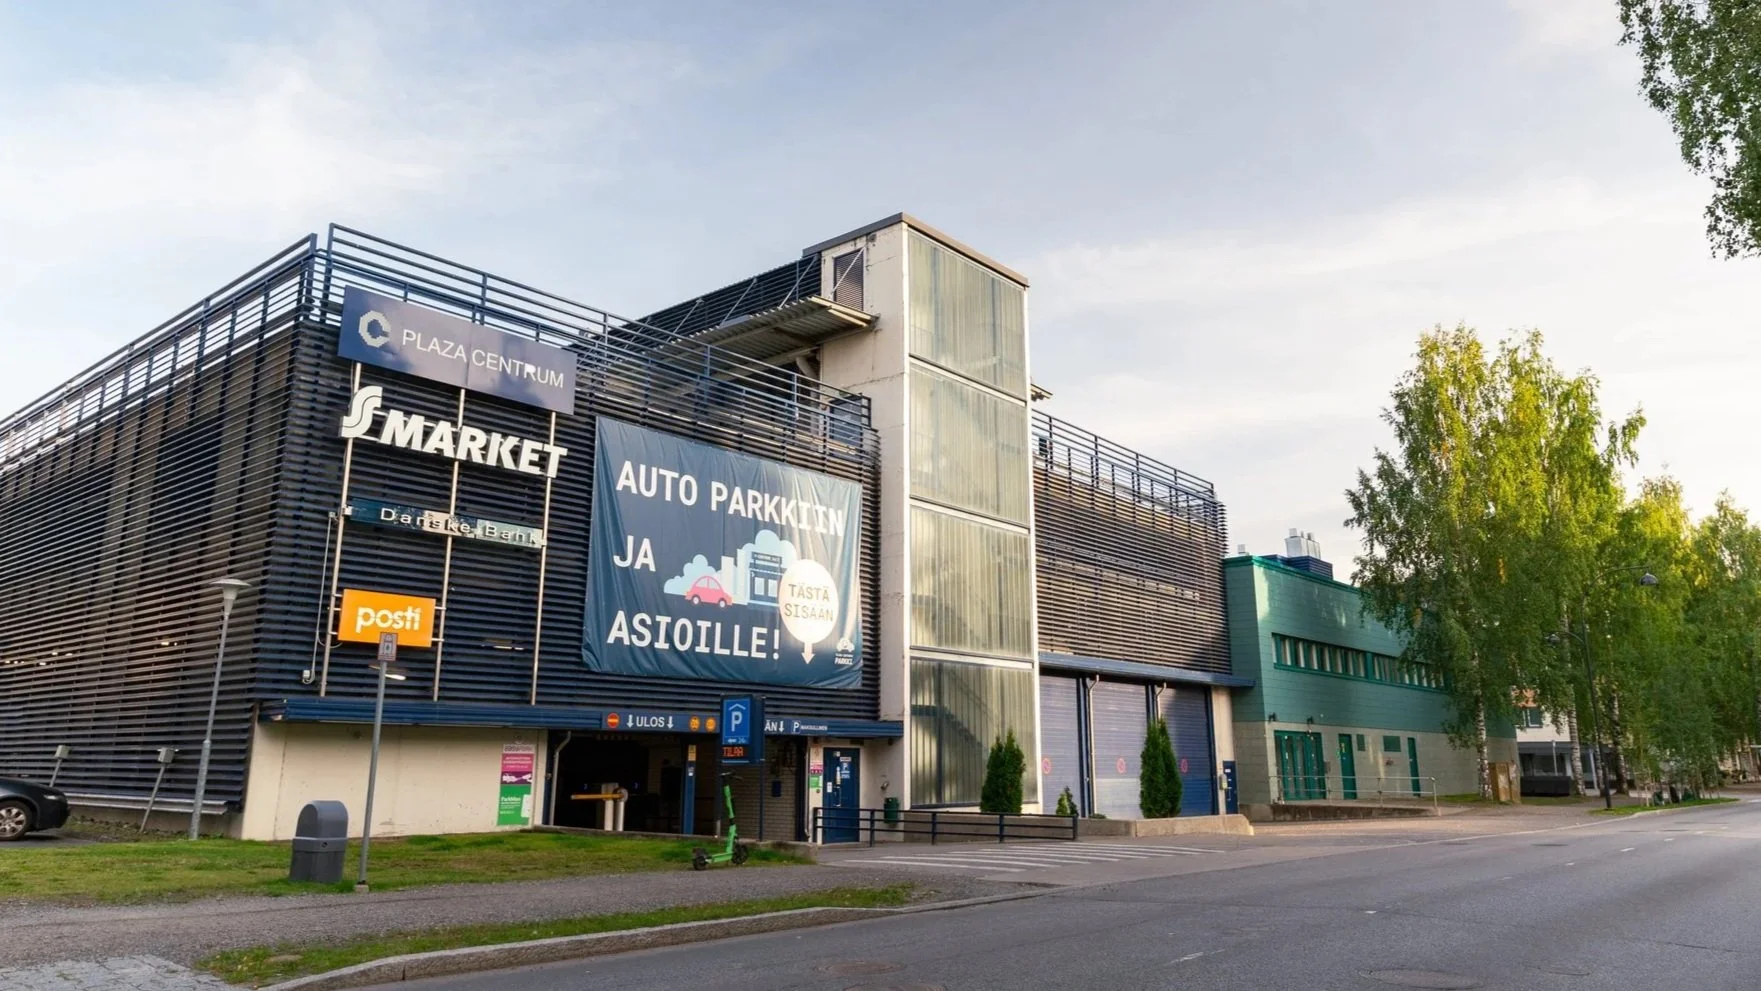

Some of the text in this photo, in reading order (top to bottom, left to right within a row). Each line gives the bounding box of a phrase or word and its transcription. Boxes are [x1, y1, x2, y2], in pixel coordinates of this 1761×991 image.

[402, 329, 565, 388] PLAZA CENTRUM
[616, 460, 843, 537] AUTO PARKKIIN
[380, 507, 539, 547] Danske Bank
[613, 535, 656, 572] JA
[788, 582, 830, 602] TÄSTÄ
[355, 605, 421, 633] posti
[606, 610, 780, 661] ASIOILLE!
[636, 716, 665, 728] ULOS
[731, 711, 743, 732] P
